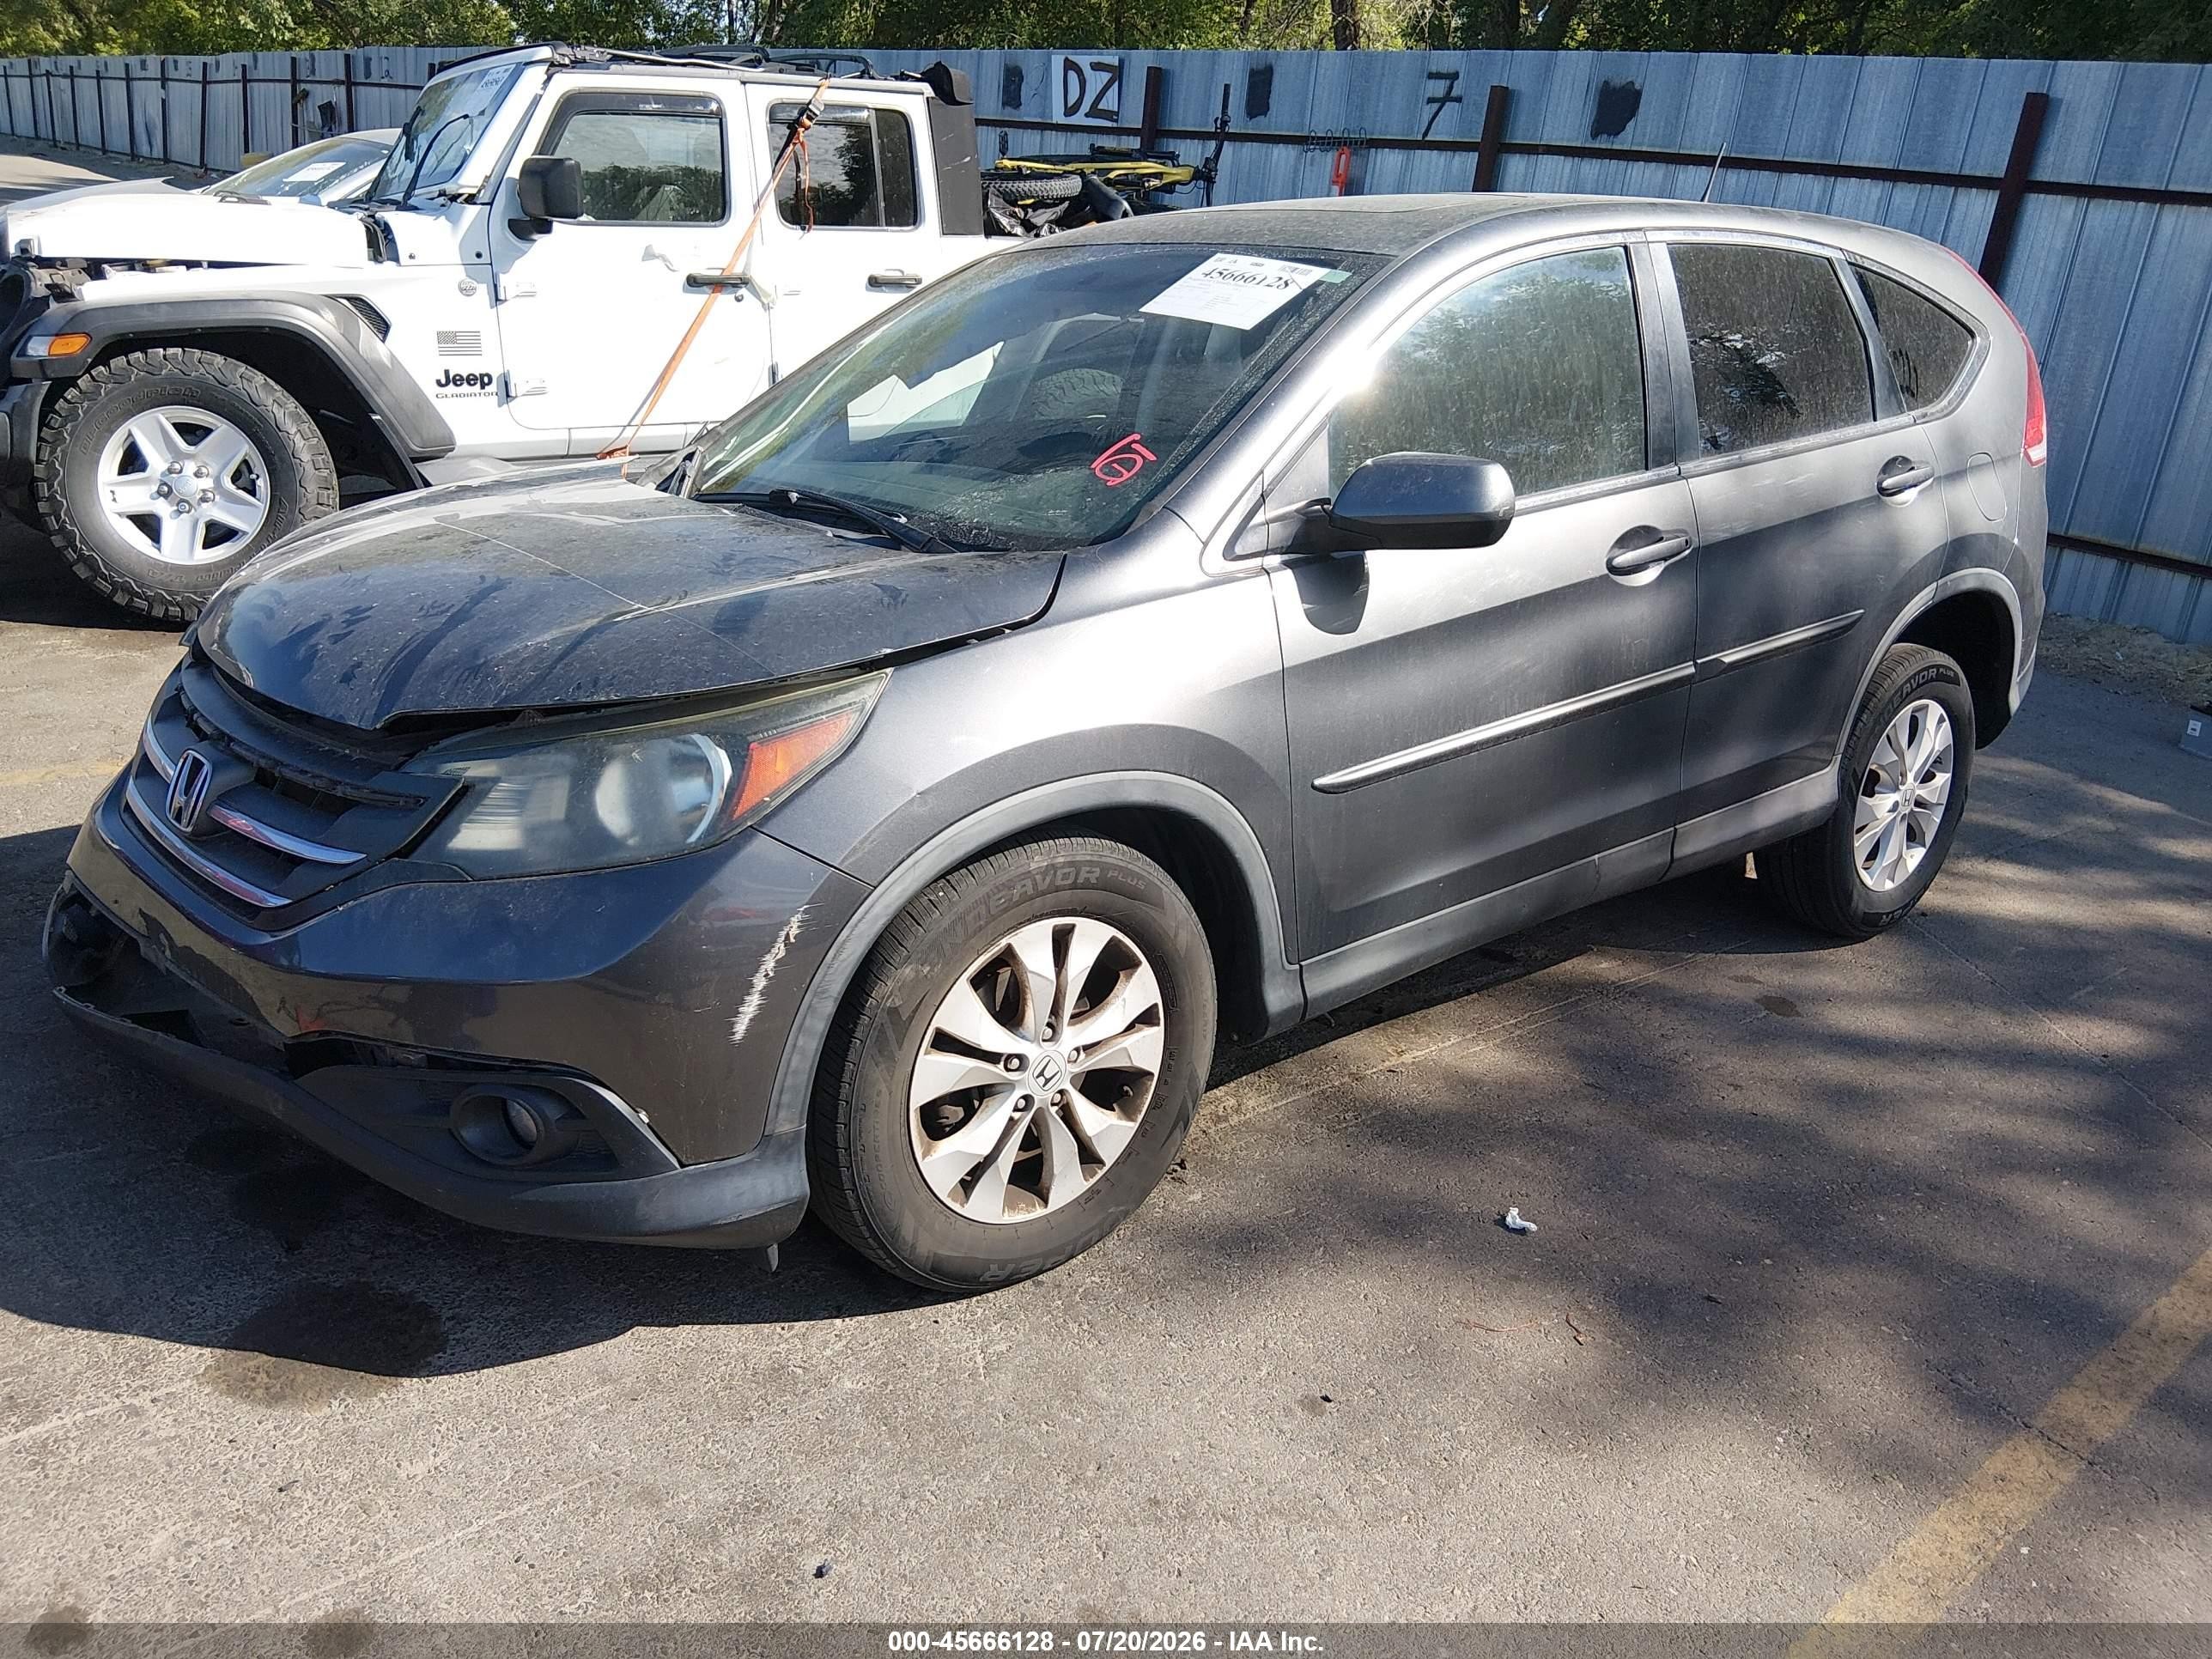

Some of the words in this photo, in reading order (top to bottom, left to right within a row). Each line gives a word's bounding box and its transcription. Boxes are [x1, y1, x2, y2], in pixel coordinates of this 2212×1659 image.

[1063, 57, 1119, 123] DZ
[1423, 71, 1462, 141] 7
[1202, 267, 1291, 290] 45666128
[435, 368, 493, 390] Jeep
[1107, 869, 1146, 890] PLUS
